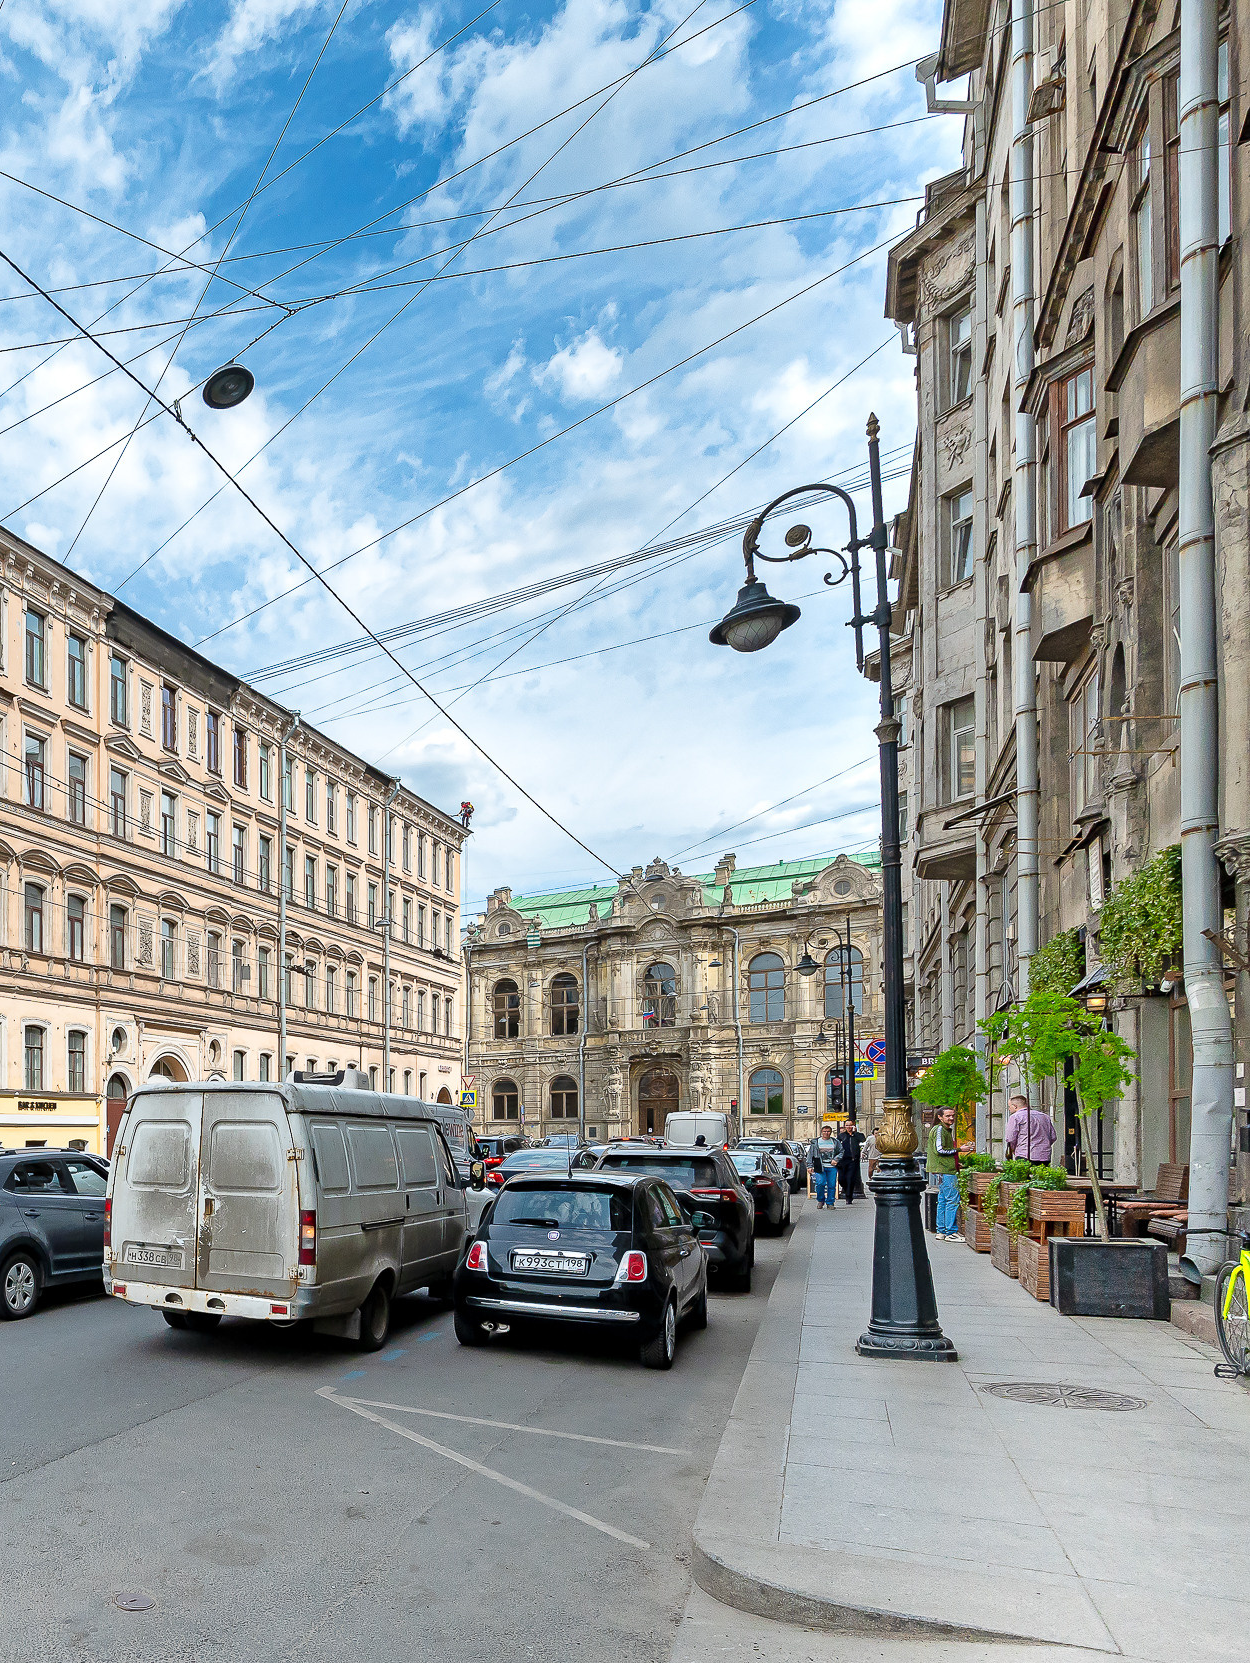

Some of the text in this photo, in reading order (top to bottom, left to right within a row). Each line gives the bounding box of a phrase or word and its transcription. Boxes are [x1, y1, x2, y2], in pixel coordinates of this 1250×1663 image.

[17, 1101, 29, 1110] BAR
[131, 1250, 167, 1264] Н338СВ
[518, 1256, 584, 1269] К993СТ 198
